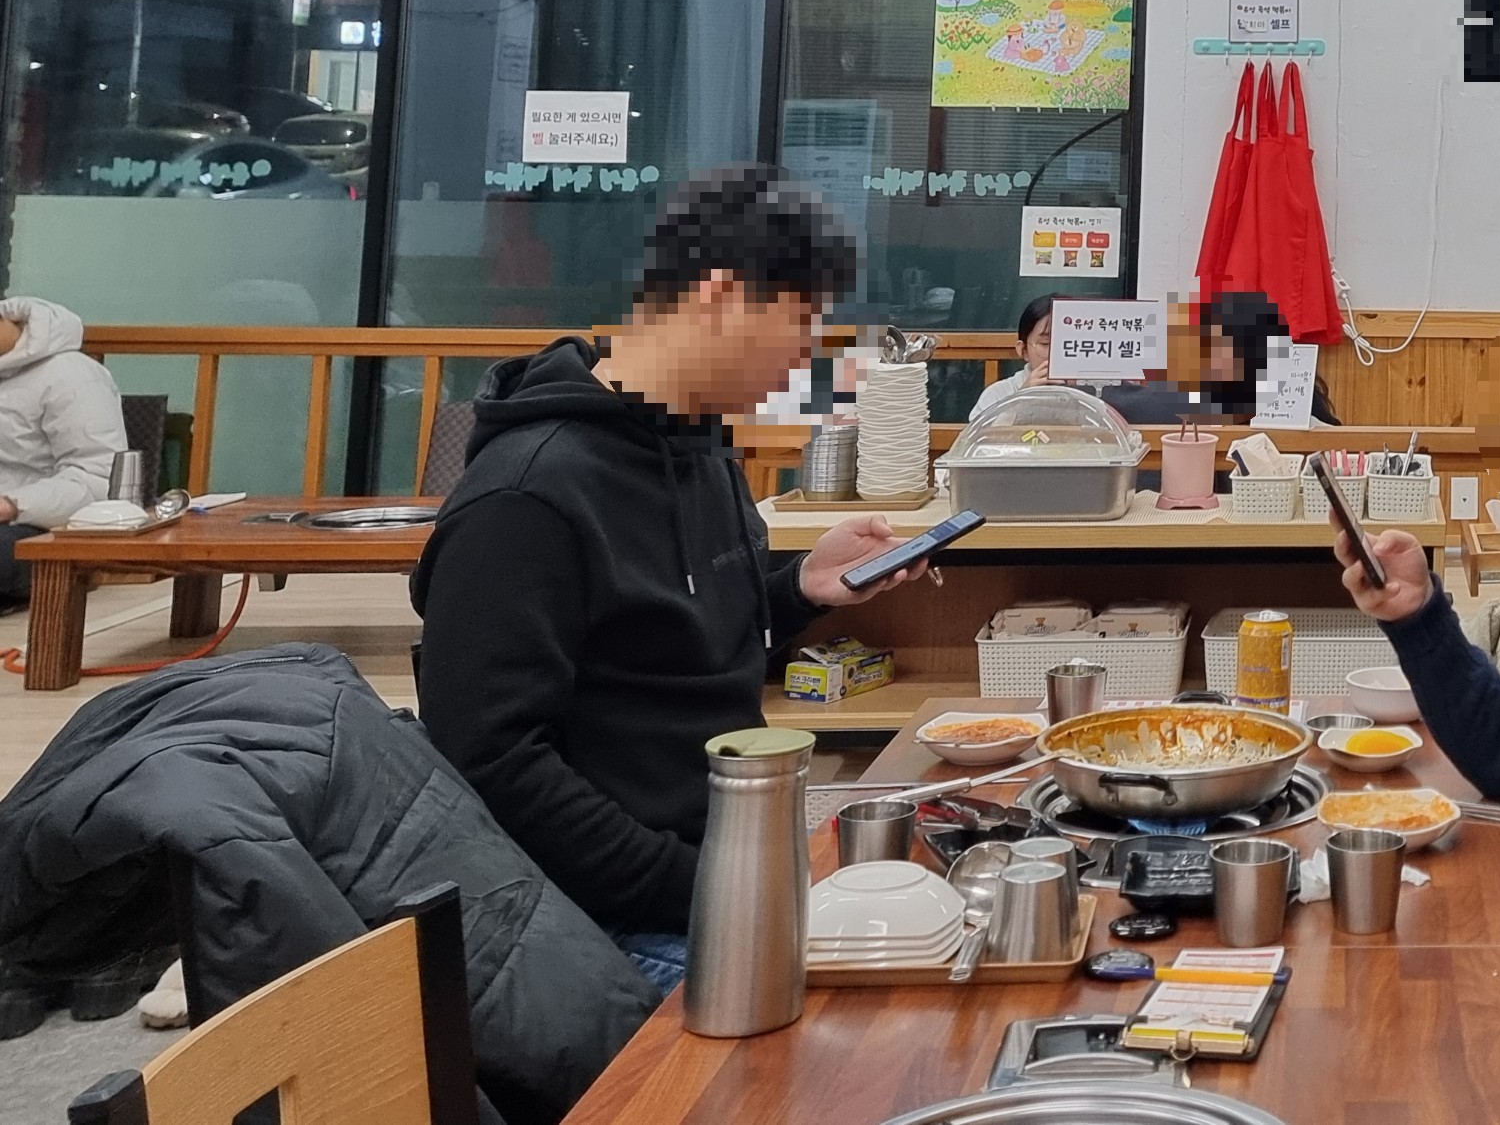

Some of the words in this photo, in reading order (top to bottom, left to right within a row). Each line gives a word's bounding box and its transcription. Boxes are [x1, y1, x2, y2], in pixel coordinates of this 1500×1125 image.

[1272, 5, 1291, 14] 떡볶이
[1270, 19, 1291, 30] 셀프
[532, 112, 562, 123] 필요한
[566, 112, 577, 123] 게
[580, 112, 622, 124] 있으시면
[532, 132, 544, 145] 벨
[549, 132, 618, 147] 눌러주세요;)
[1074, 318, 1094, 331] 유성
[1098, 318, 1118, 331] 즉석
[1122, 318, 1144, 332] 떡볶
[1063, 340, 1112, 358] 단무지
